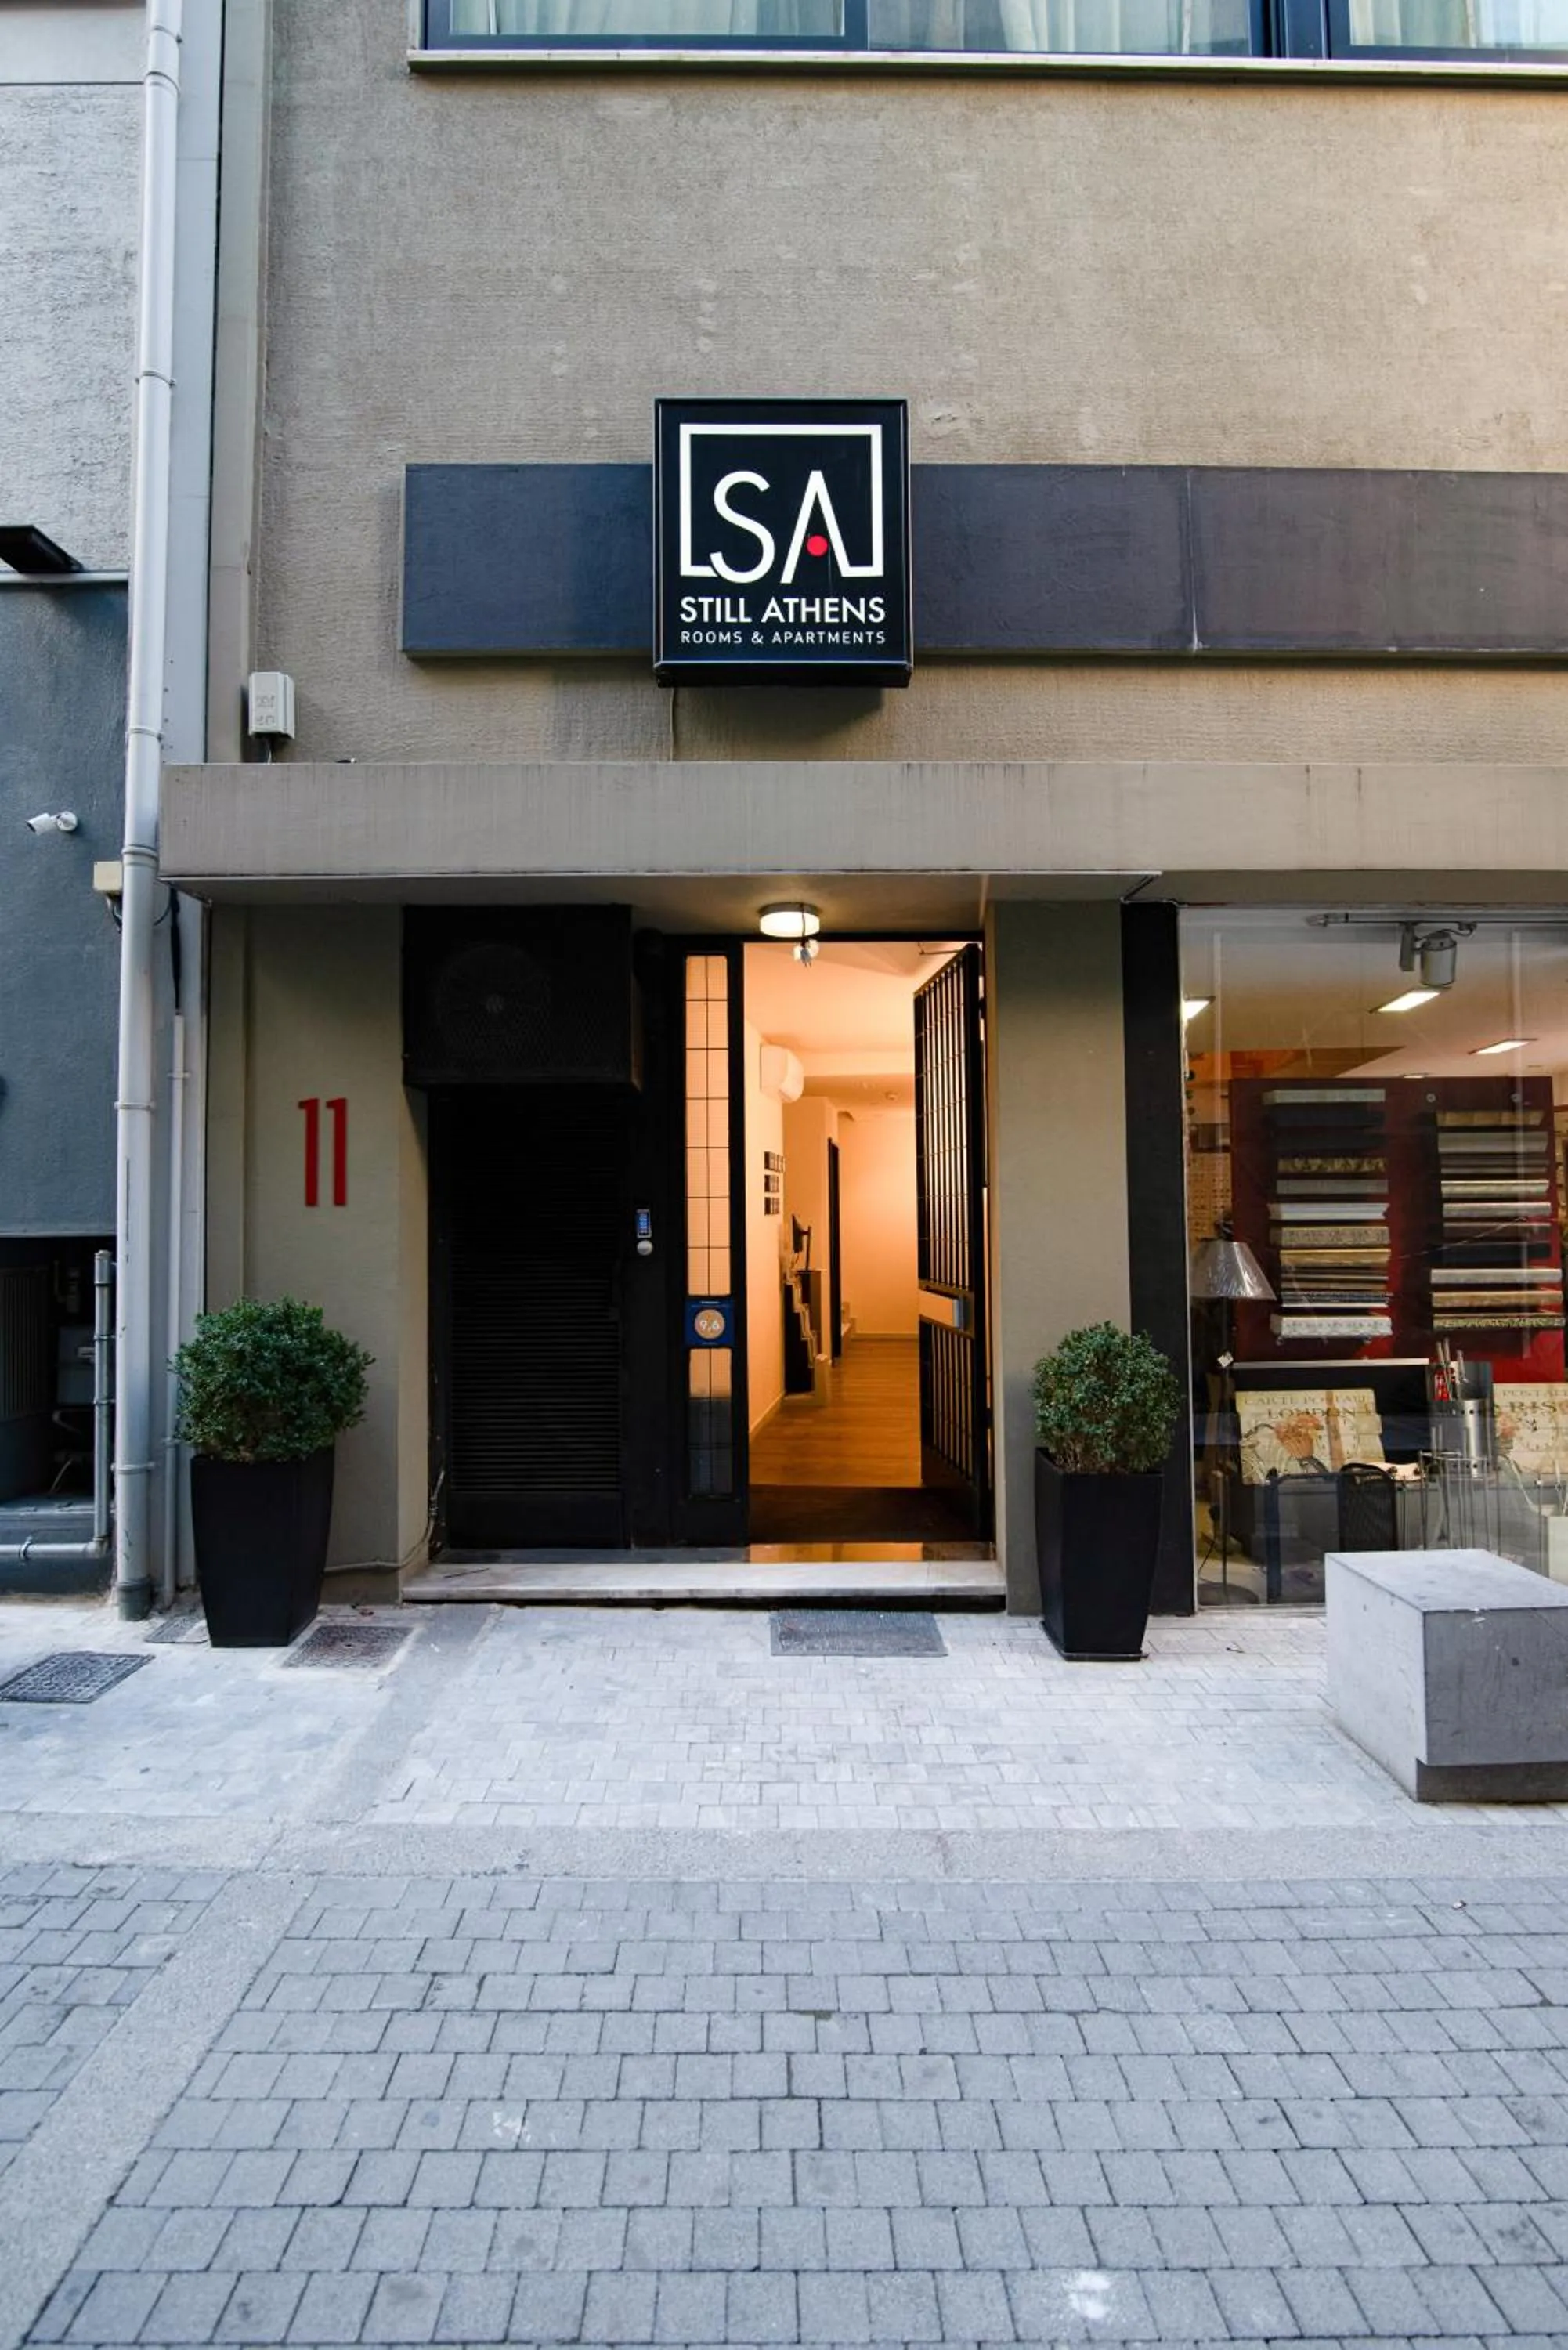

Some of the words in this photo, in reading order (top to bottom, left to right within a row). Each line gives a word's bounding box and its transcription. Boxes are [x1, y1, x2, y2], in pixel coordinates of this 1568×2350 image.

[710, 470, 850, 584] SA
[680, 596, 752, 623] STILL
[761, 596, 885, 624] ATHENS
[681, 631, 742, 644] ROOMS
[751, 631, 764, 645] &
[771, 631, 885, 644] APARTMENTS
[298, 1097, 347, 1207] 11
